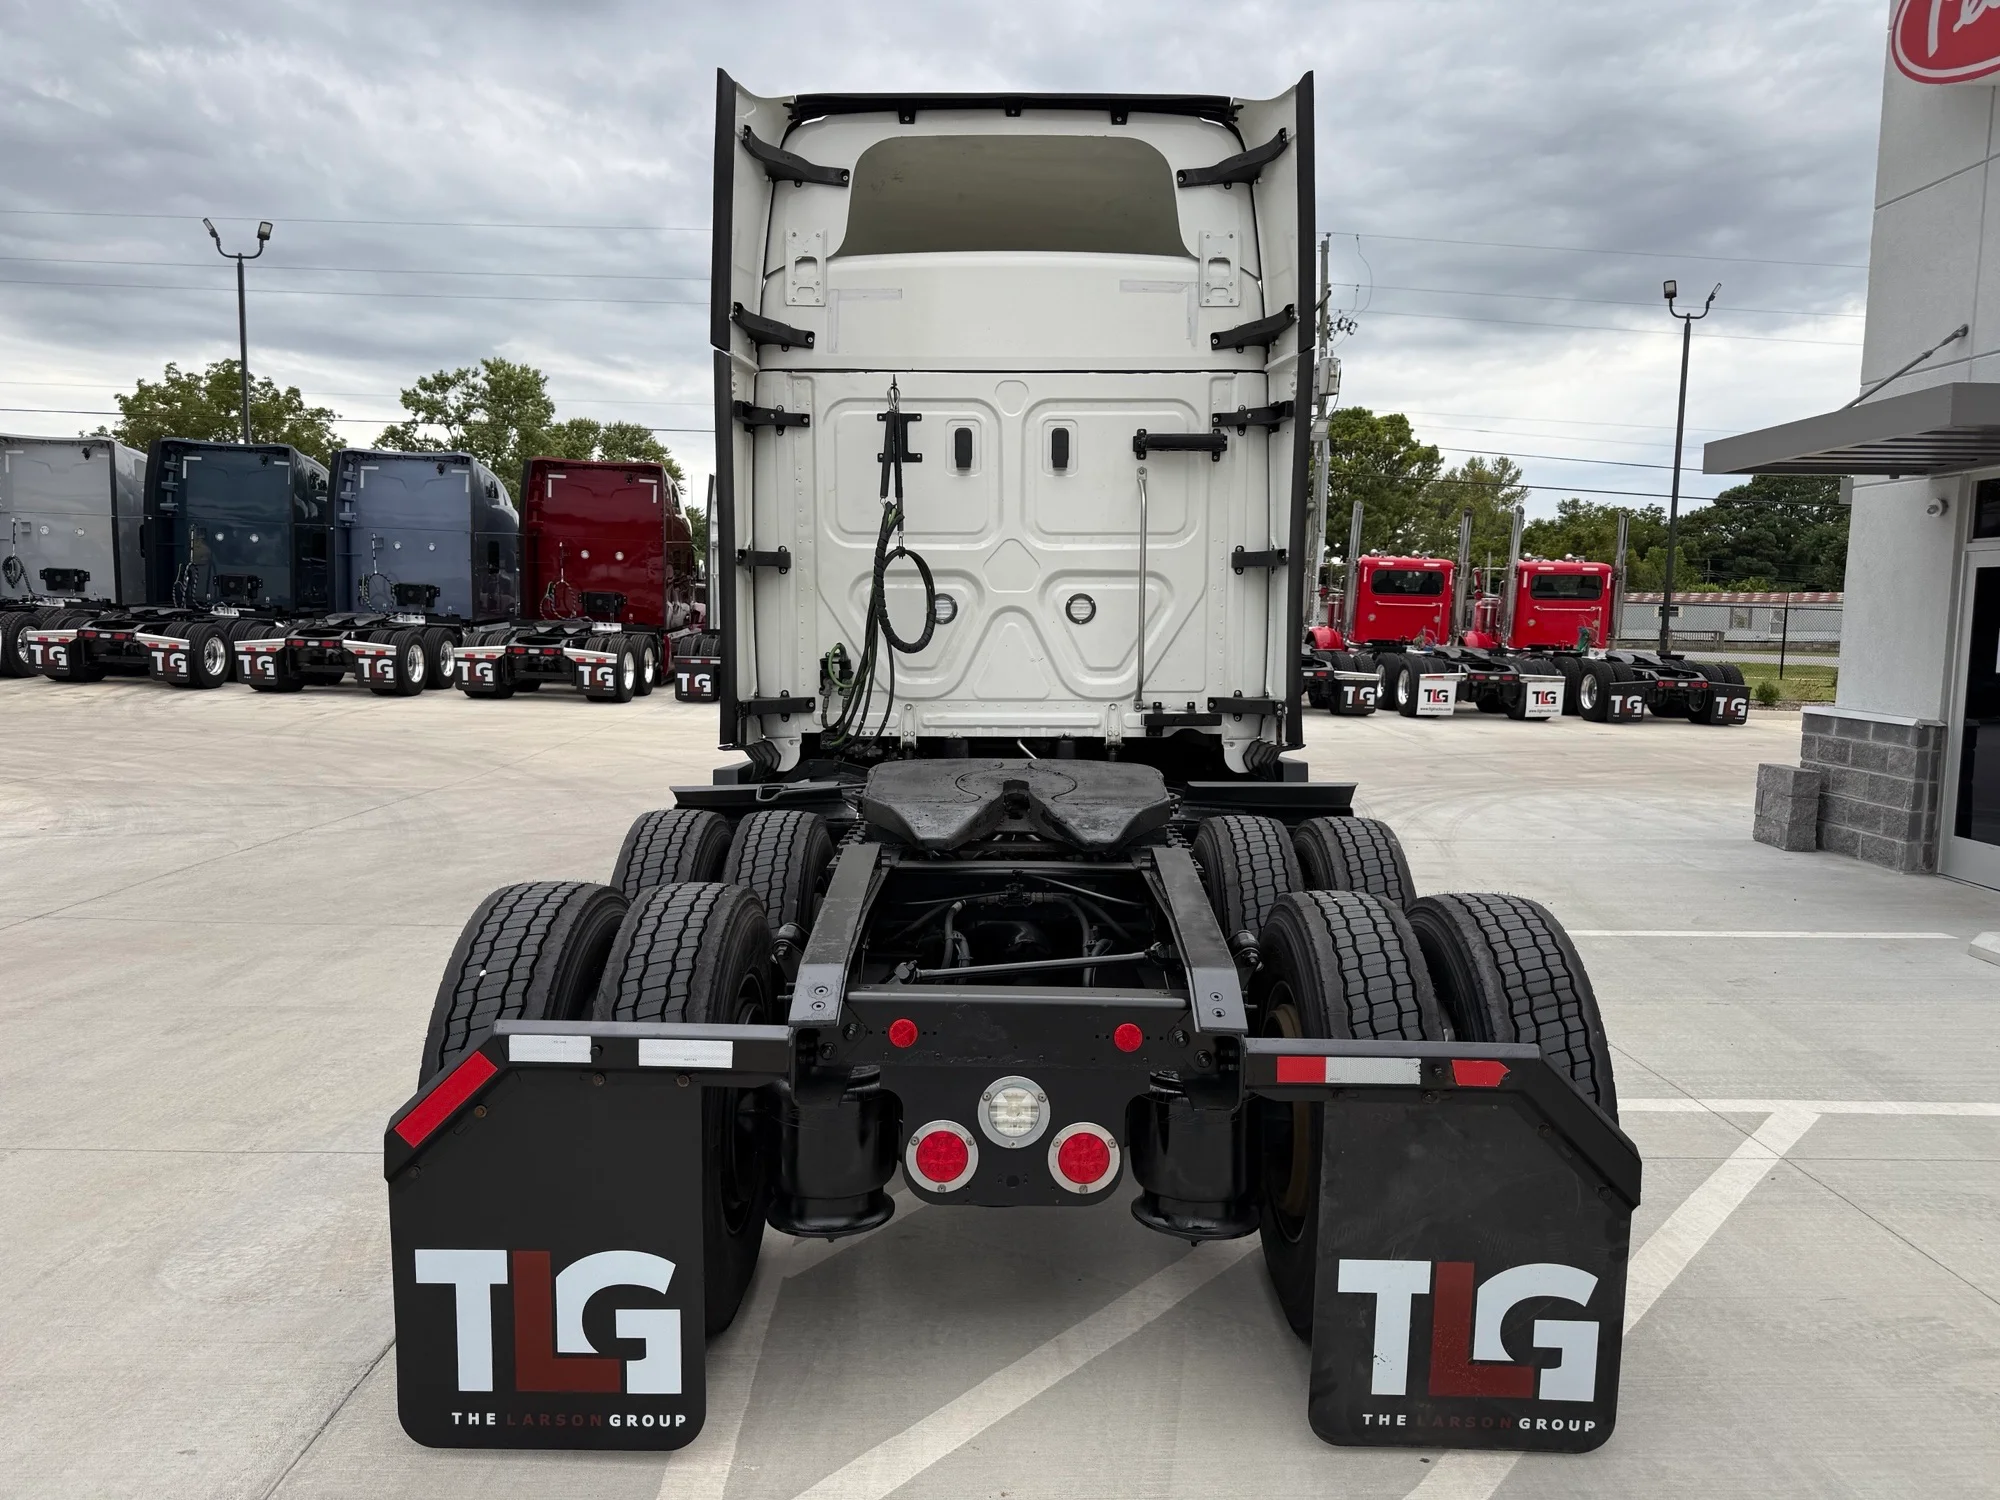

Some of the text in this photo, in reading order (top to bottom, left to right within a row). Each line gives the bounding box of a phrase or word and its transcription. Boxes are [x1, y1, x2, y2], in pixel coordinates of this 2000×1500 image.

[30, 645, 67, 666] TLG
[151, 651, 187, 673] TLG
[238, 655, 275, 676] TLG
[358, 658, 394, 679] TLG
[457, 661, 494, 682] TLG
[578, 666, 614, 687] TLG
[677, 673, 712, 693] TLG
[1343, 686, 1375, 706] TLG
[1424, 689, 1449, 703] TLG
[1532, 691, 1557, 705] TLG
[1610, 695, 1643, 714] TLG
[1715, 696, 1747, 716] TLG
[415, 1249, 682, 1394] TLG
[1338, 1259, 1600, 1402] TLG
[452, 1412, 686, 1427] THE LARSON GROUP
[1362, 1413, 1596, 1432] THE LARSON GROUP
